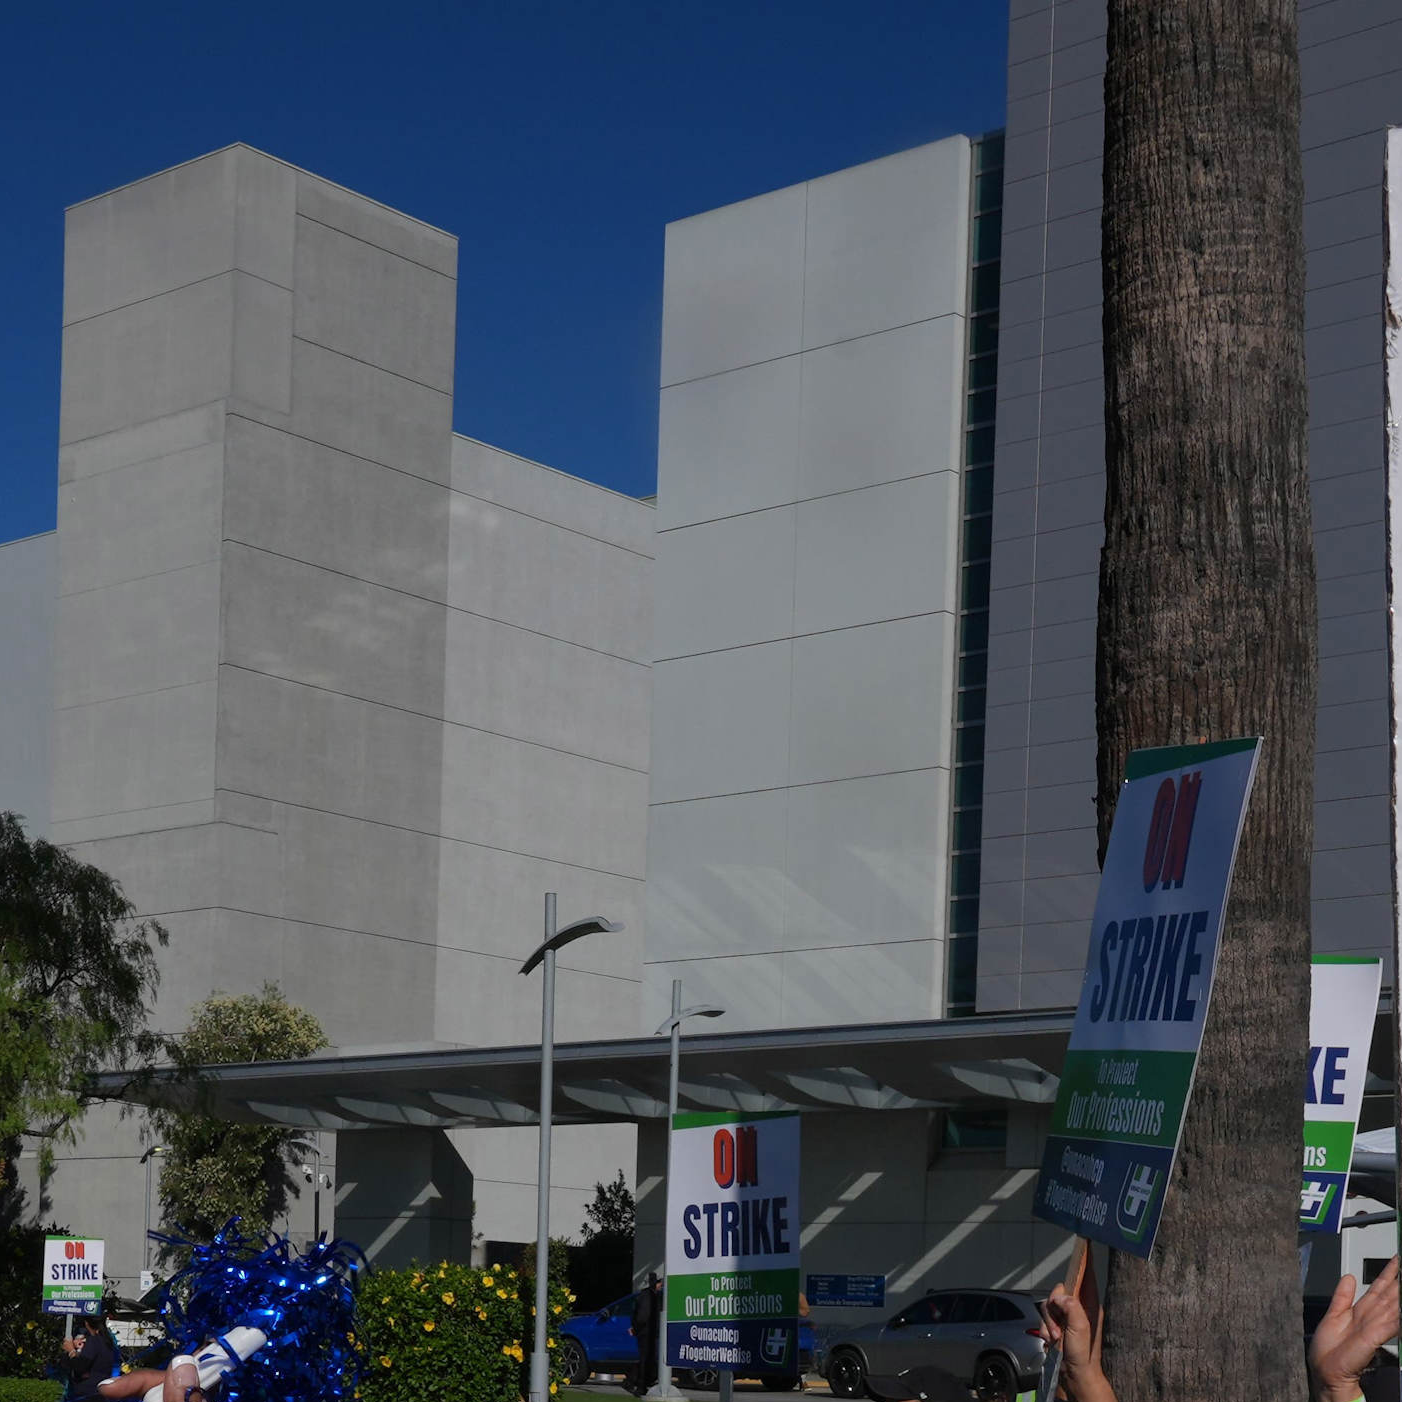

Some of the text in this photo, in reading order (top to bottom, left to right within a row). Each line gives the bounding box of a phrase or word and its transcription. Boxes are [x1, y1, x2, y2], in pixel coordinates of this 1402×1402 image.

[1143, 770, 1202, 894] ON
[1090, 910, 1209, 1023] STRIKE
[1107, 1058, 1139, 1086] Protect
[1067, 1090, 1164, 1136] Our Professions
[714, 1126, 758, 1189] ON
[683, 1197, 790, 1259] STRIKE
[65, 1241, 85, 1260] ON
[51, 1263, 98, 1280] STRIKE
[710, 1275, 752, 1291] To Protect
[685, 1292, 782, 1317] Our Professions
[690, 1325, 739, 1344] @unacuhcp
[679, 1344, 751, 1364] #TogetherWeRise
